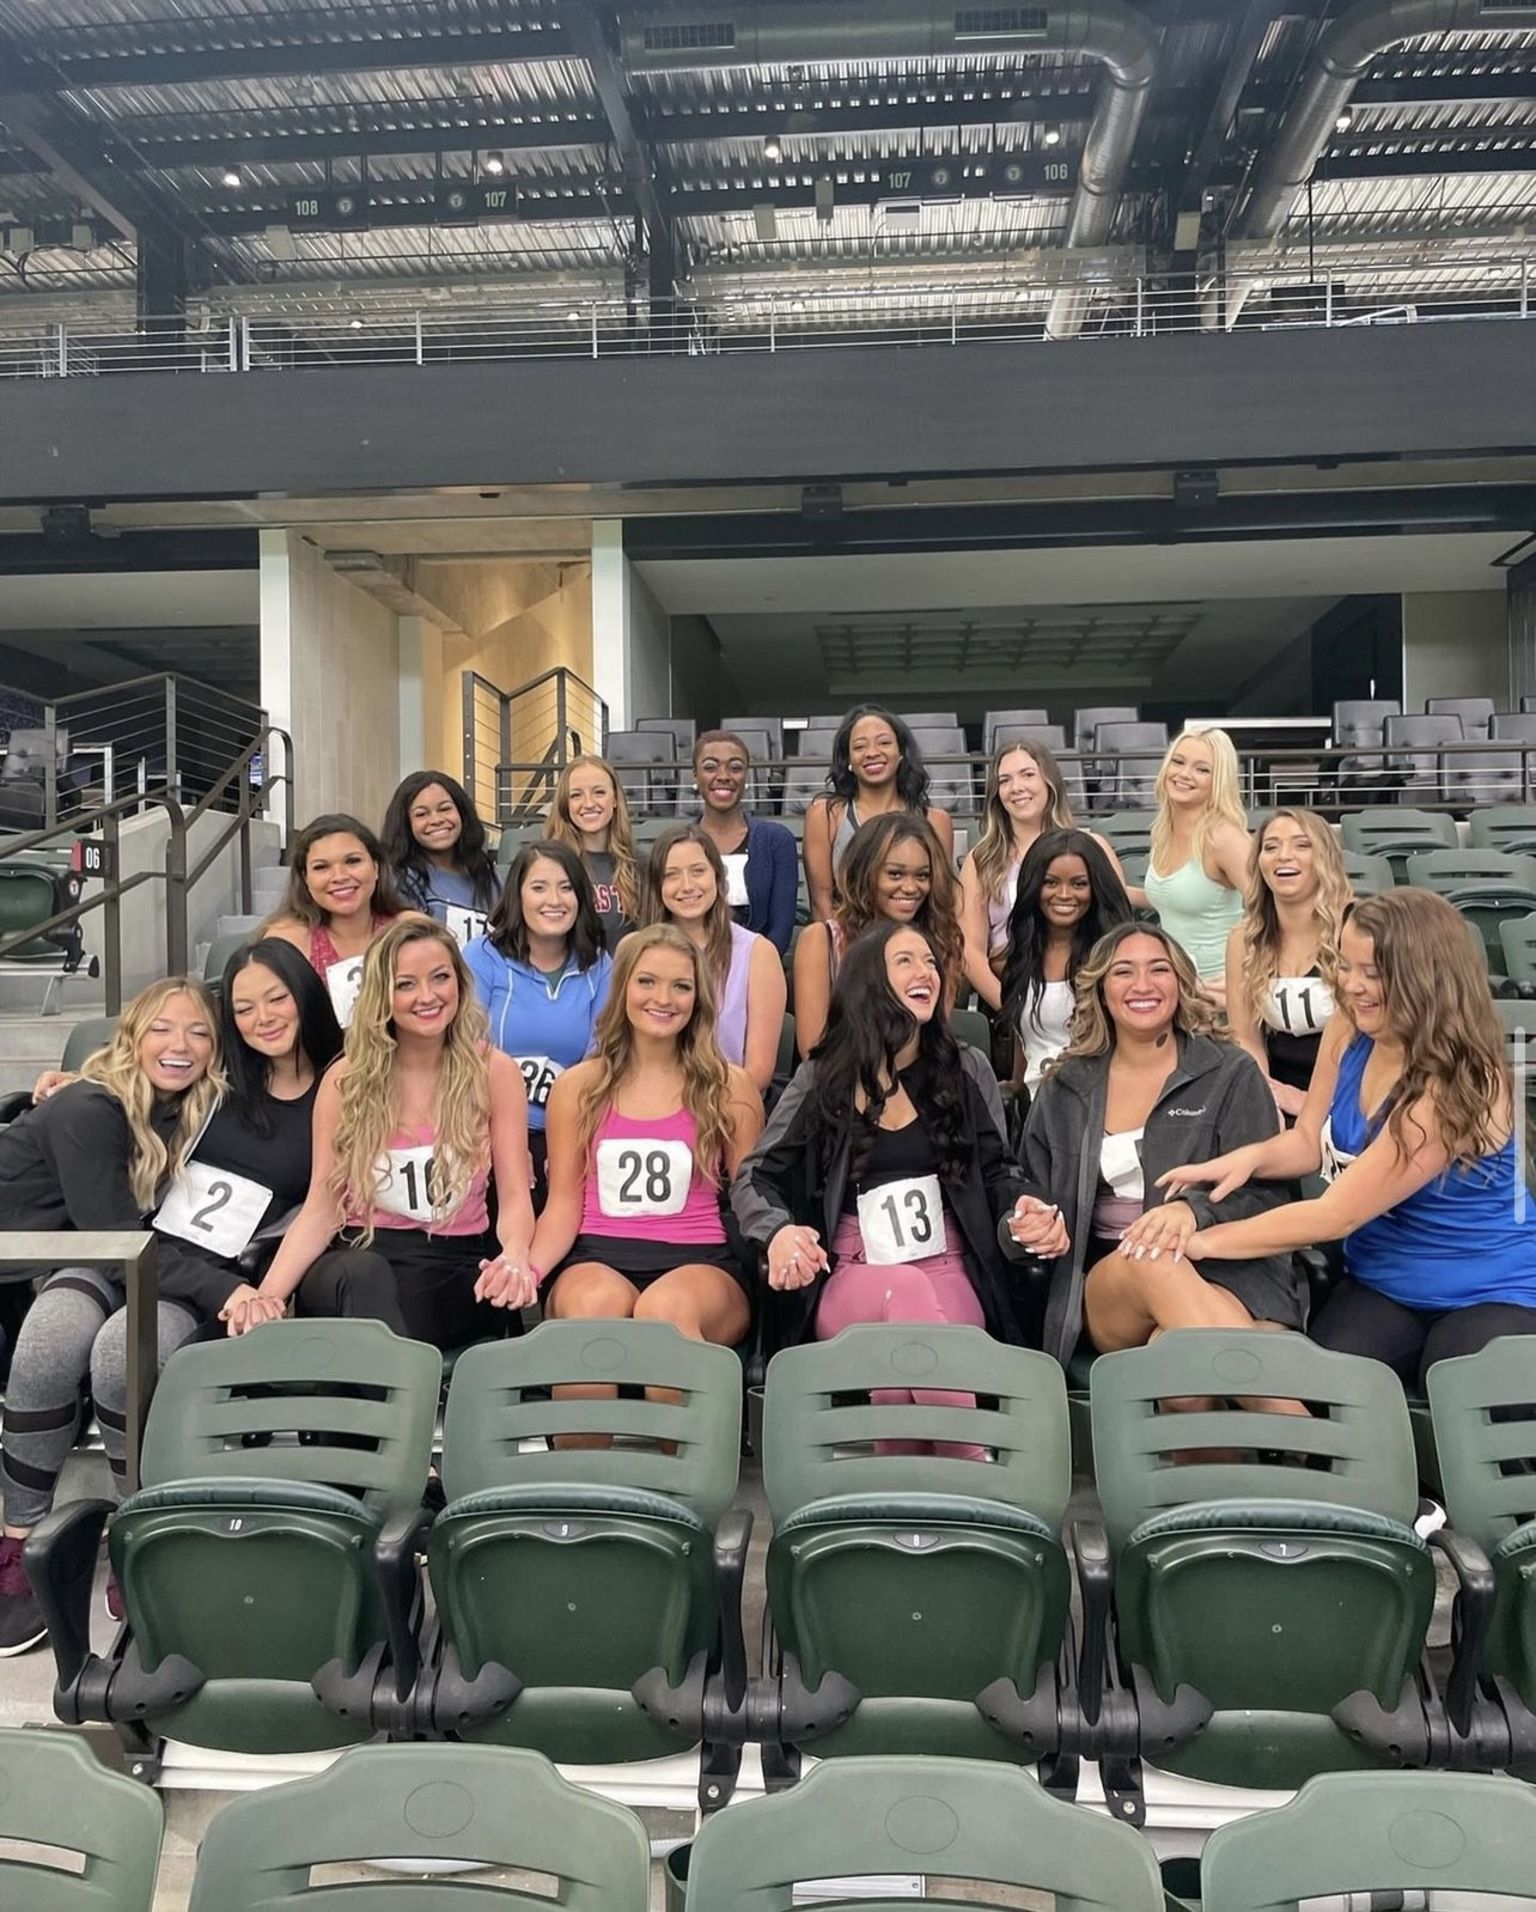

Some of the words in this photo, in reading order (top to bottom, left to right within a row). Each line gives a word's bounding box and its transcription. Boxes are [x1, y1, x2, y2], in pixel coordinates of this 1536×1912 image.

[888, 172, 912, 189] 107
[295, 200, 319, 216] 108
[484, 191, 507, 208] 107
[86, 846, 100, 869] 06
[1275, 987, 1316, 1030] 11
[618, 1150, 671, 1203] 28
[190, 1180, 233, 1233] 2
[880, 1188, 932, 1248] 13
[230, 1518, 243, 1531] 10
[561, 1524, 569, 1537] 9
[913, 1534, 920, 1546] 8
[1279, 1543, 1287, 1556] 7
